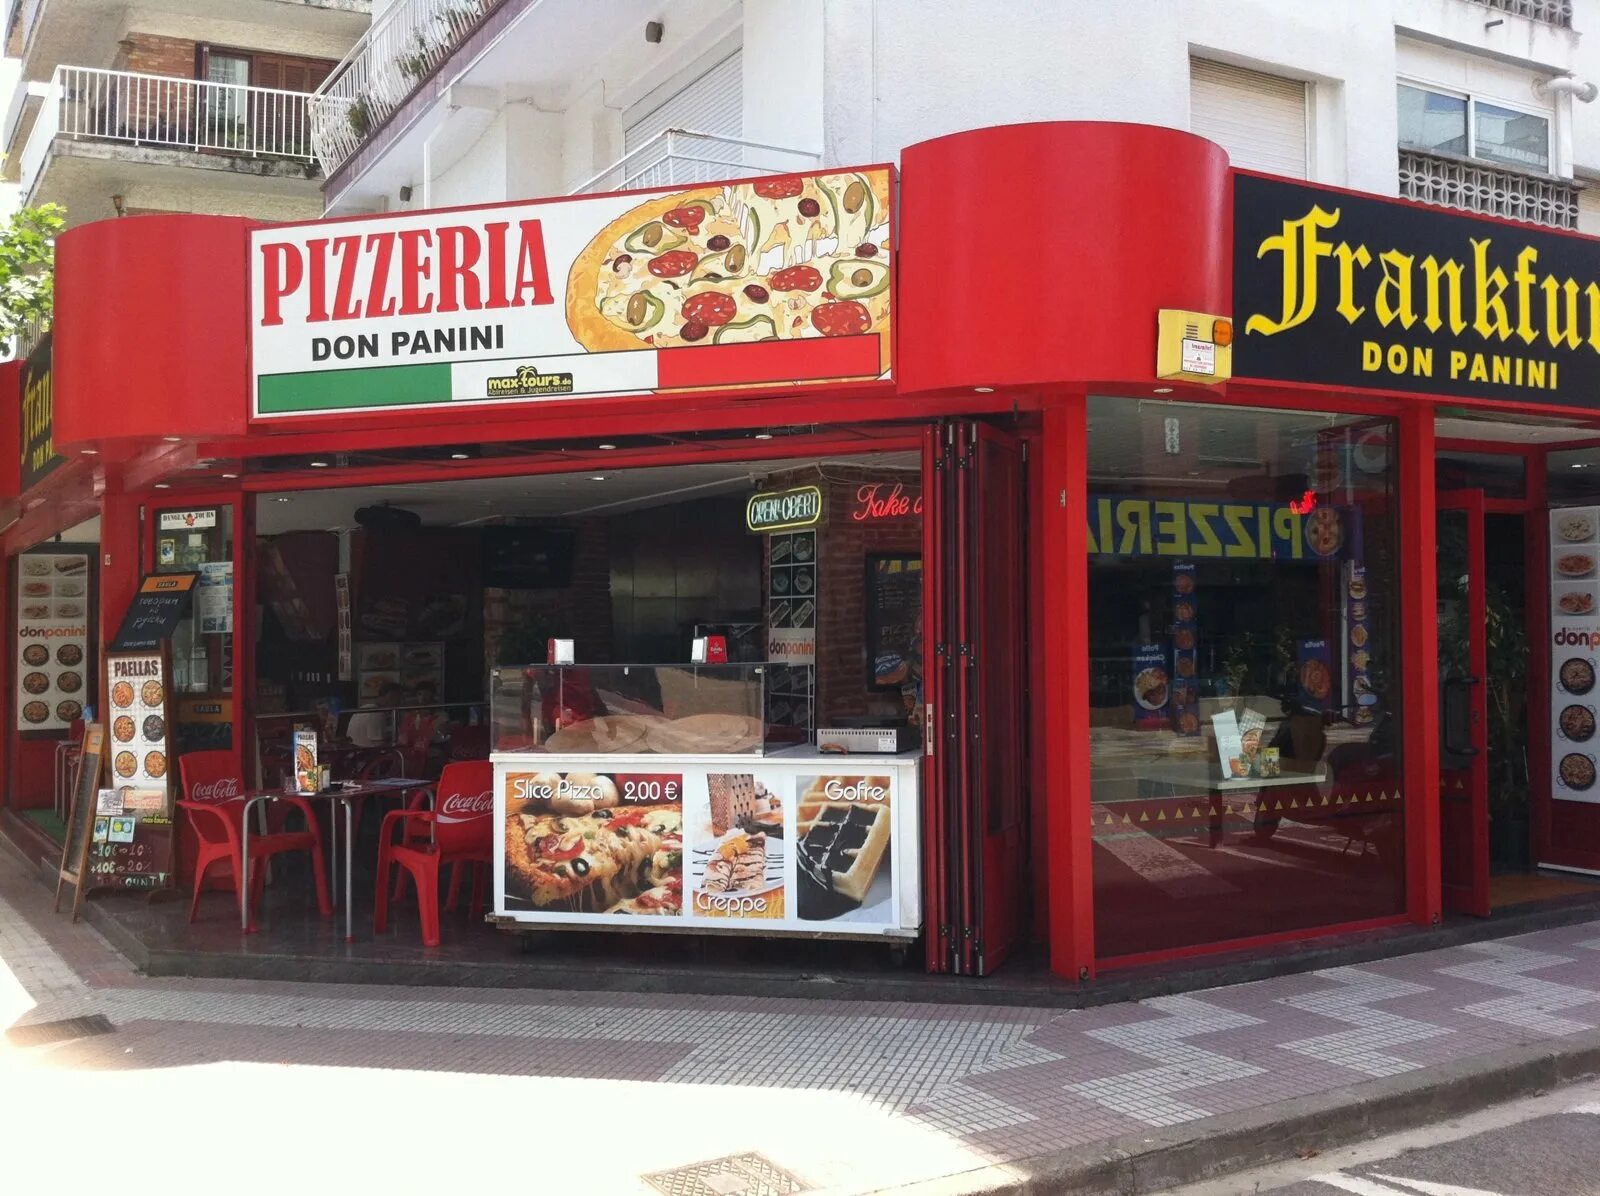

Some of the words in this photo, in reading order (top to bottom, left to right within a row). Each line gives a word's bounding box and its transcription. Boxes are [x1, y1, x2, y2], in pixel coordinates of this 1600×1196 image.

[261, 218, 555, 327] PIZZERIA
[311, 332, 379, 362] DON
[391, 324, 504, 356] PANINI
[1362, 340, 1433, 378] DON
[1450, 349, 1558, 391] PANINI
[853, 482, 910, 520] Take
[19, 625, 86, 641] donpanini
[114, 659, 159, 678] PAELLAS
[192, 778, 238, 802] Coca-Cola
[513, 779, 553, 800] Slice
[557, 780, 604, 801] Pizza
[624, 781, 661, 802] 2,00
[665, 781, 678, 801] €
[824, 779, 886, 801] Gofre
[696, 892, 768, 918] Creppe
